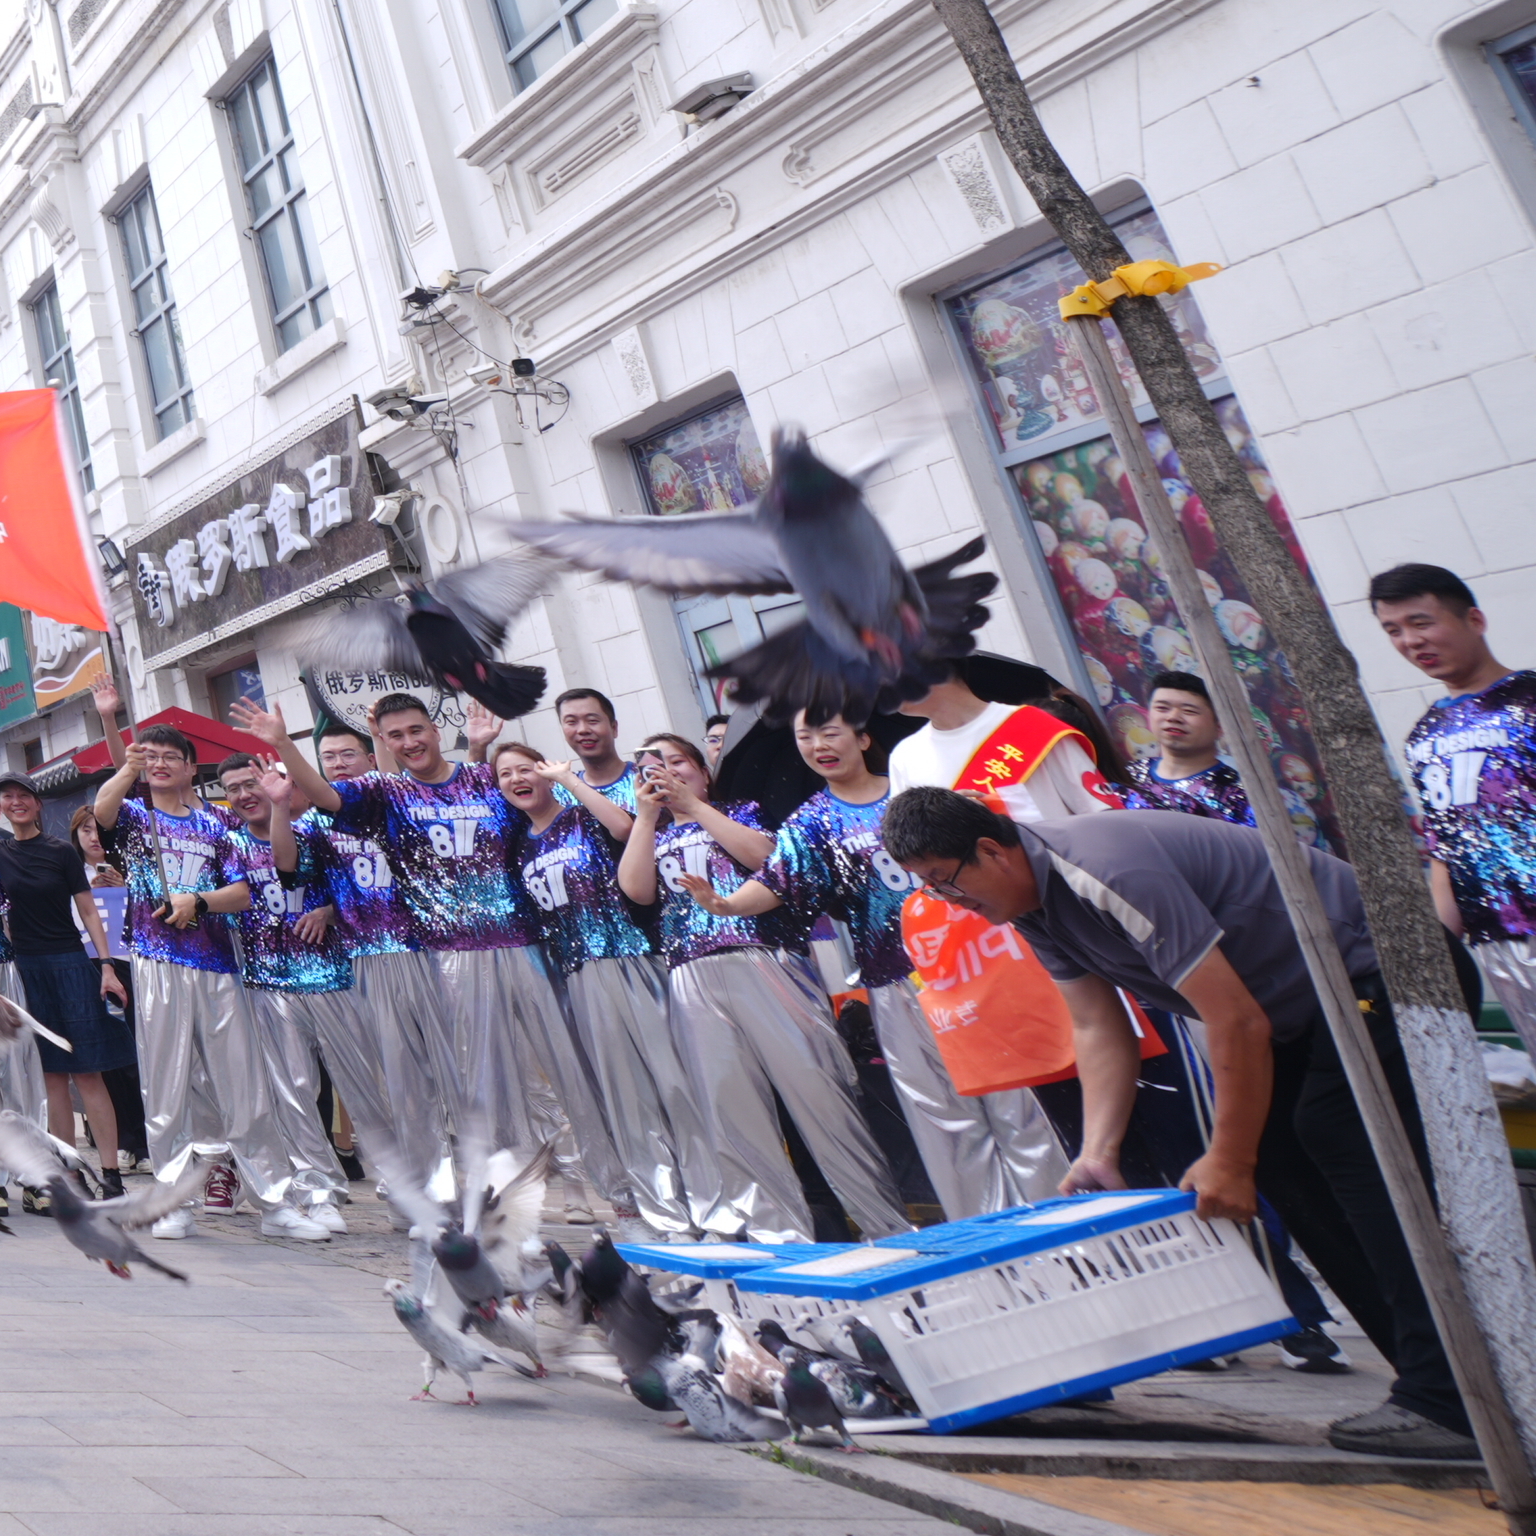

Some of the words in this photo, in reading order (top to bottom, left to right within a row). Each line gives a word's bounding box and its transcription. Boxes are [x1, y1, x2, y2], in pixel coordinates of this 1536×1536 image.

[408, 806, 437, 821] THE
[439, 805, 491, 820] DESIGN
[171, 837, 216, 860] DESIGN
[336, 840, 362, 854] THE
[536, 846, 579, 868] DESIGN
